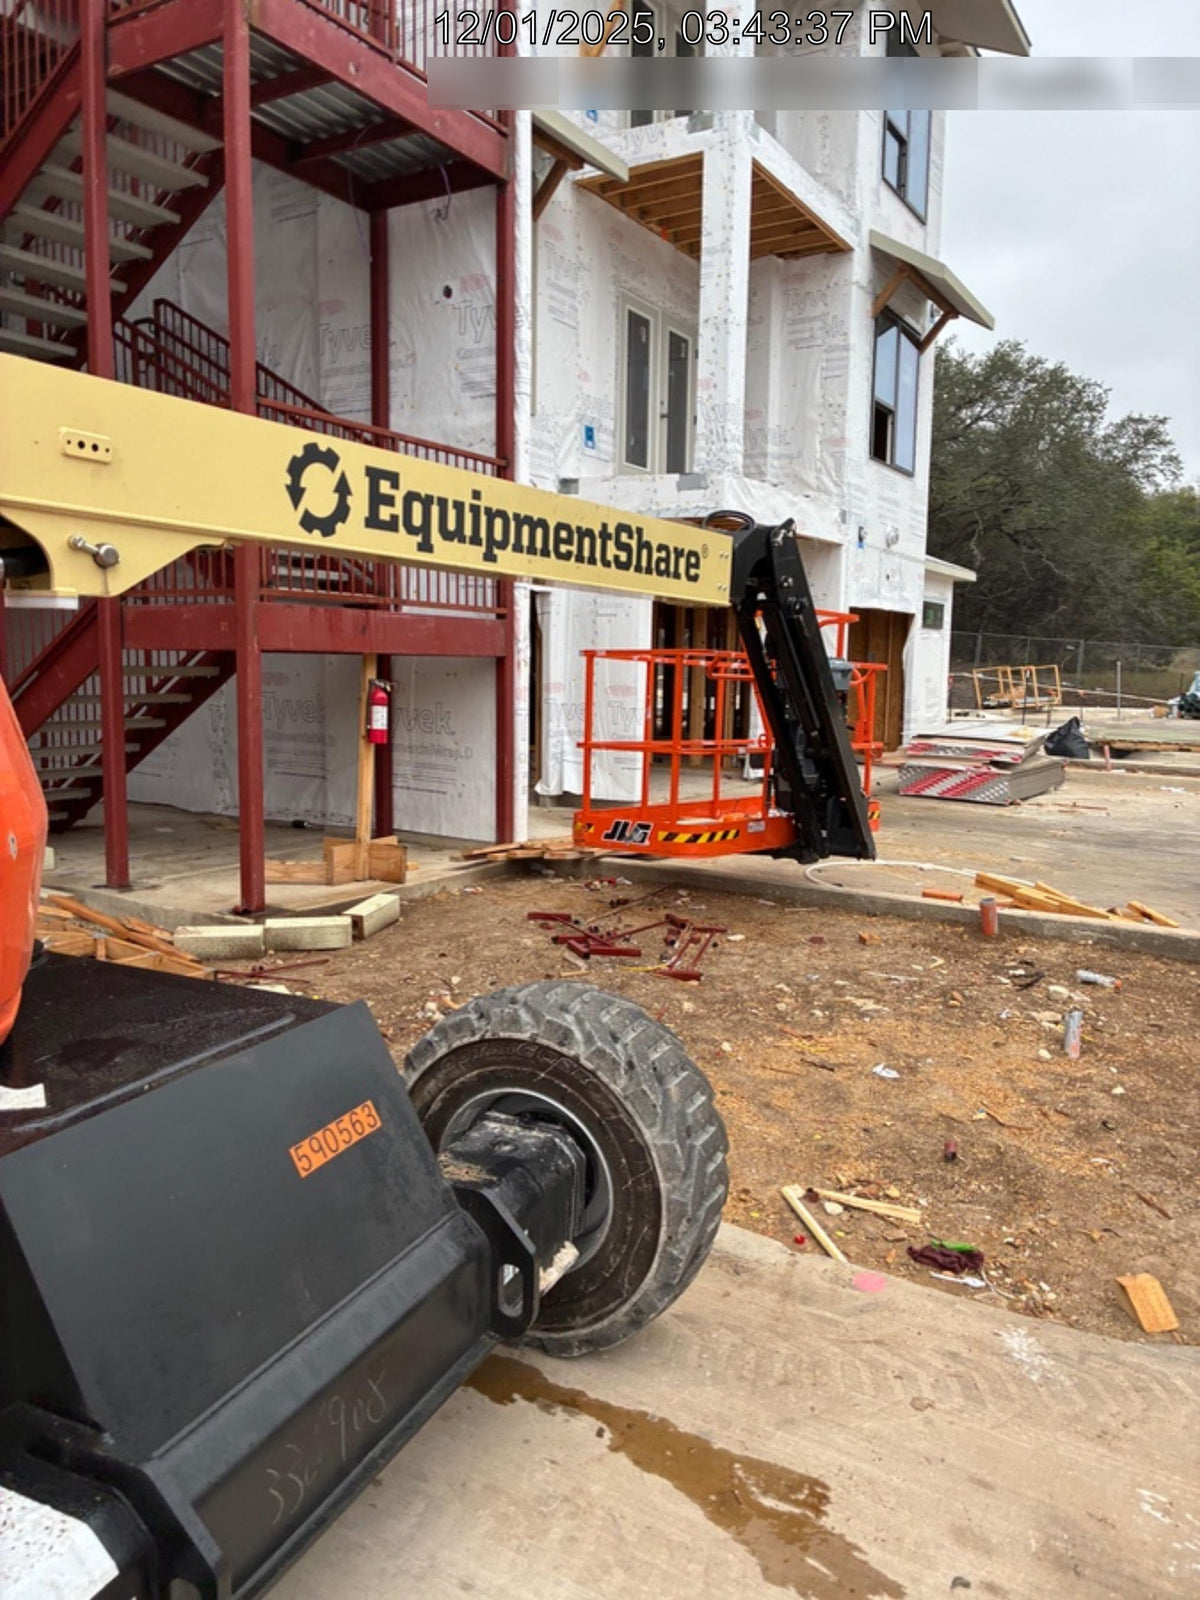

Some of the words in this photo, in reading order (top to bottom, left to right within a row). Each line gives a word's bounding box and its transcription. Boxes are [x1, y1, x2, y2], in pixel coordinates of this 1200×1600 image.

[364, 464, 701, 583] EquipmentShare
[601, 819, 654, 846] JLG
[292, 1103, 380, 1173] 590563
